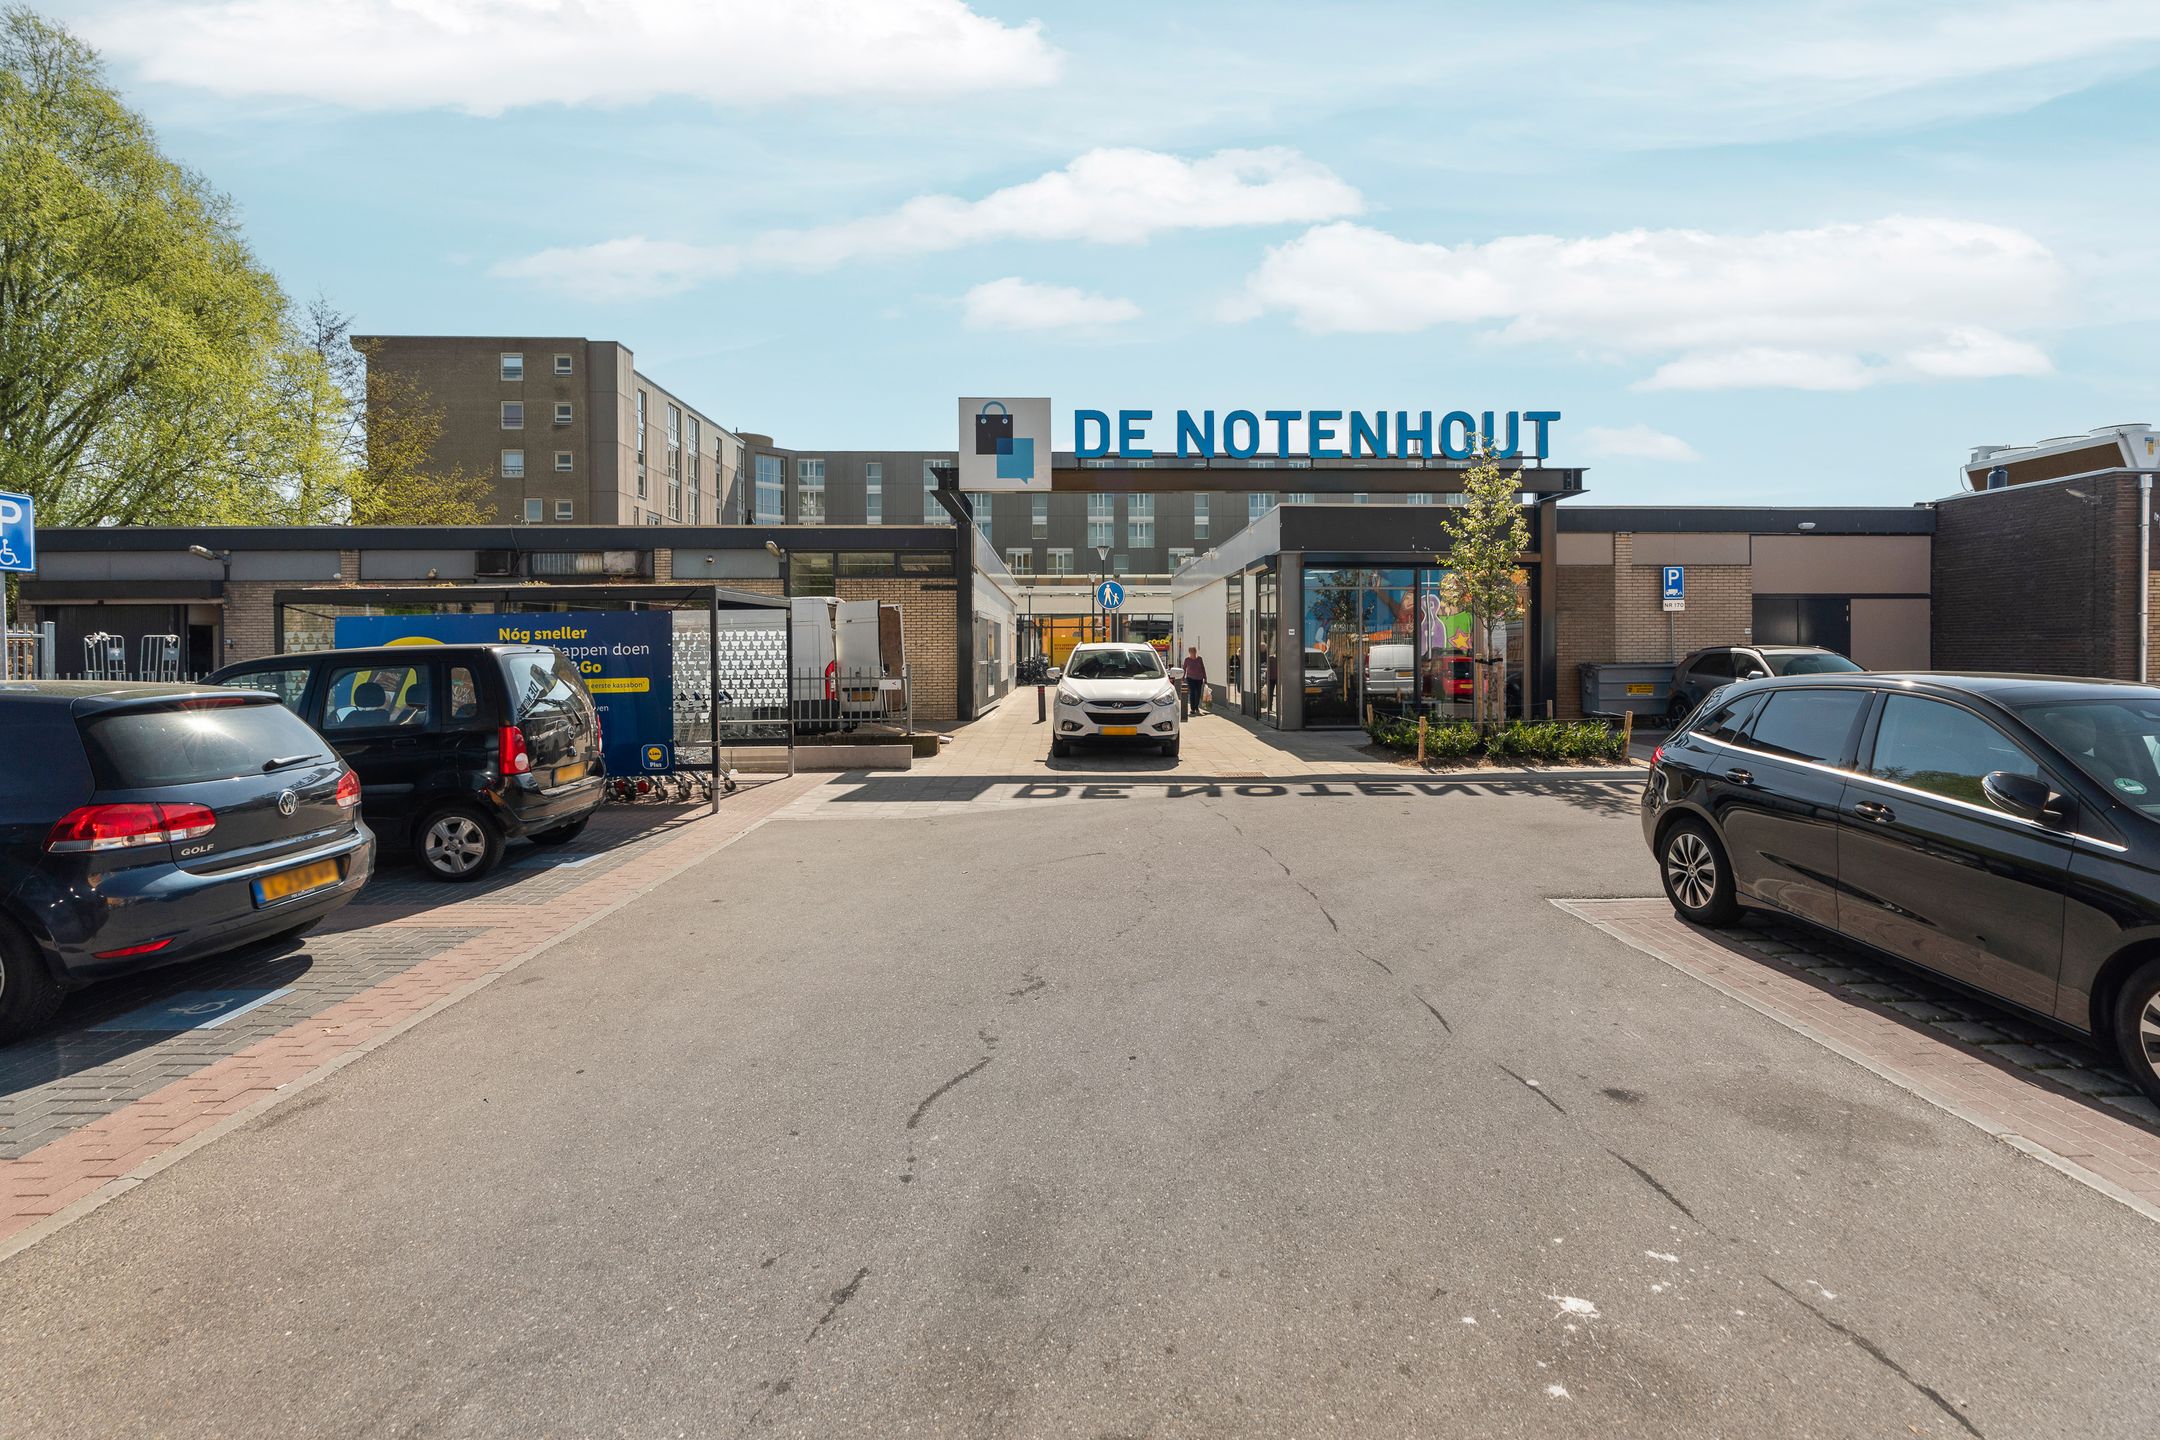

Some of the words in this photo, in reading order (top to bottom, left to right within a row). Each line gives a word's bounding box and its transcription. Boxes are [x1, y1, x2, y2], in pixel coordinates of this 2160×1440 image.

[1074, 409, 1153, 459] DE
[1176, 410, 1561, 460] NOTENHOUT
[0, 499, 22, 537] P
[1668, 569, 1680, 586] P
[498, 626, 531, 643] Nóg
[534, 626, 588, 640] sneller
[612, 643, 650, 655] doen
[180, 843, 215, 856] GOLF
